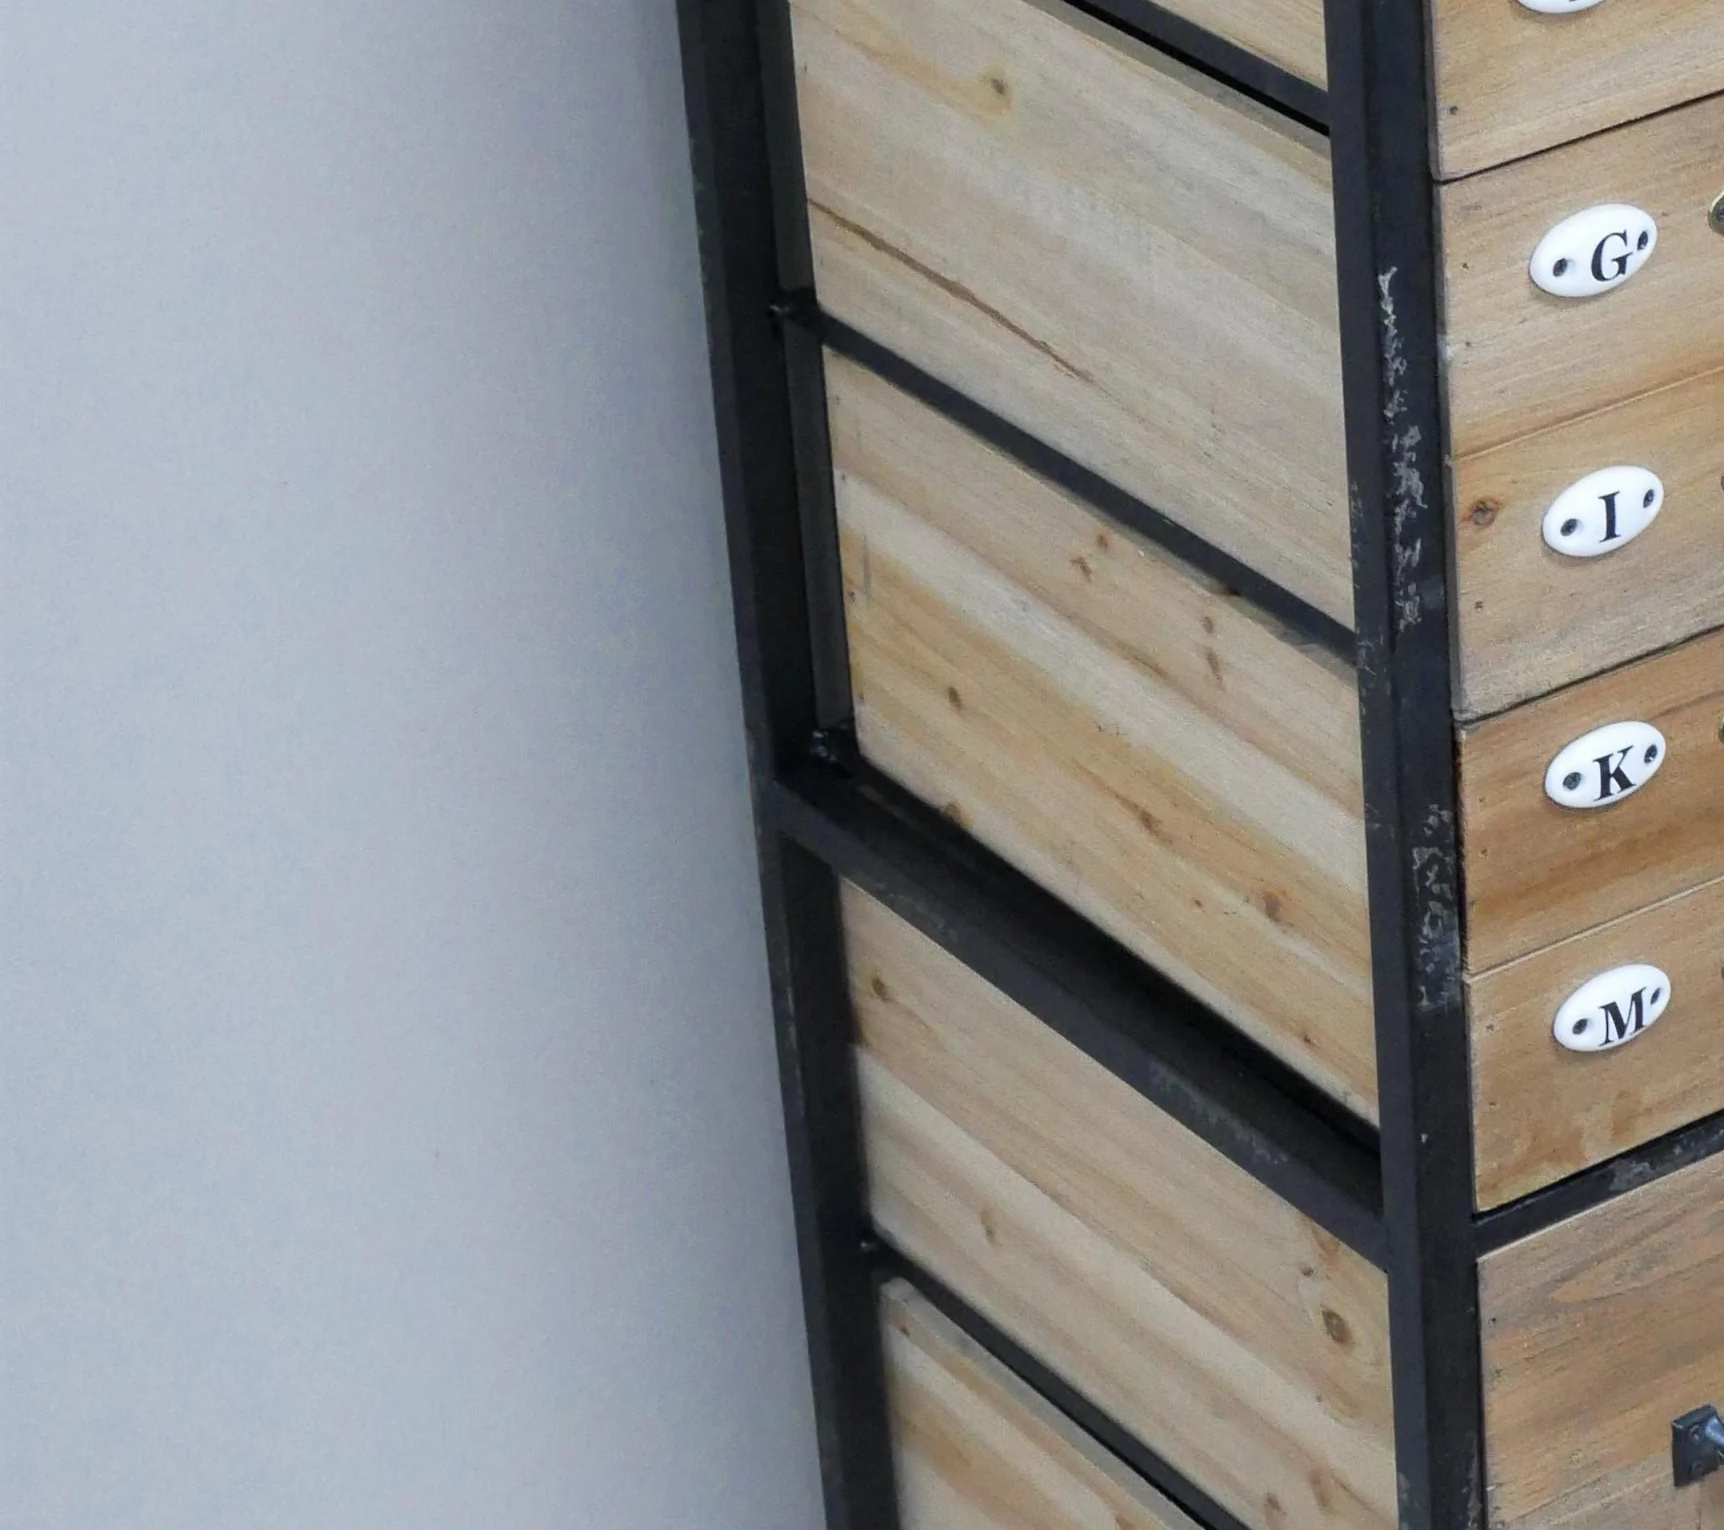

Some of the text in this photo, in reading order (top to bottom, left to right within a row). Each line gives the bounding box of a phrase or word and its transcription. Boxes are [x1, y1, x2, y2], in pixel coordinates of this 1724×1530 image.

[1591, 230, 1631, 283] G
[1598, 491, 1620, 543] I
[1593, 746, 1635, 801] K
[1599, 987, 1646, 1046] M
